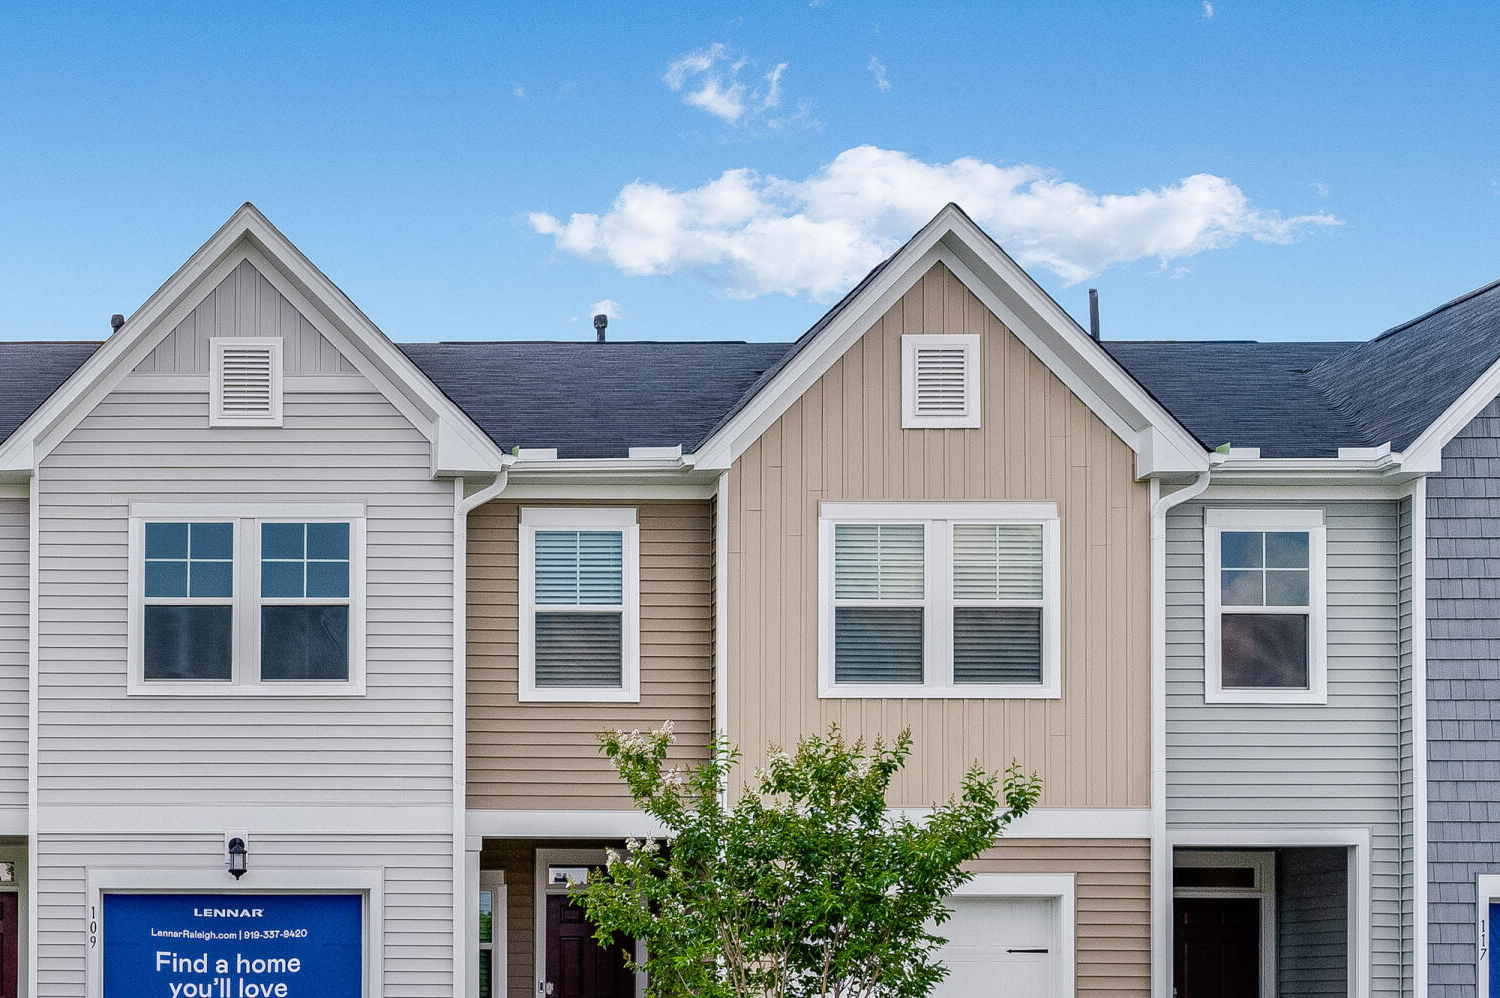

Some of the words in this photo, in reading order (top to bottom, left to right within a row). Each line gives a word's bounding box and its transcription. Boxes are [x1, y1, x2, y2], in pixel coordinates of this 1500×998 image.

[193, 908, 264, 918] LENNAR
[151, 928, 237, 941] LennarRaleigh.com
[243, 929, 308, 940] 919-337-9420
[156, 951, 208, 973] Find
[215, 959, 229, 974] a
[236, 953, 301, 974] home
[239, 977, 288, 998] love
